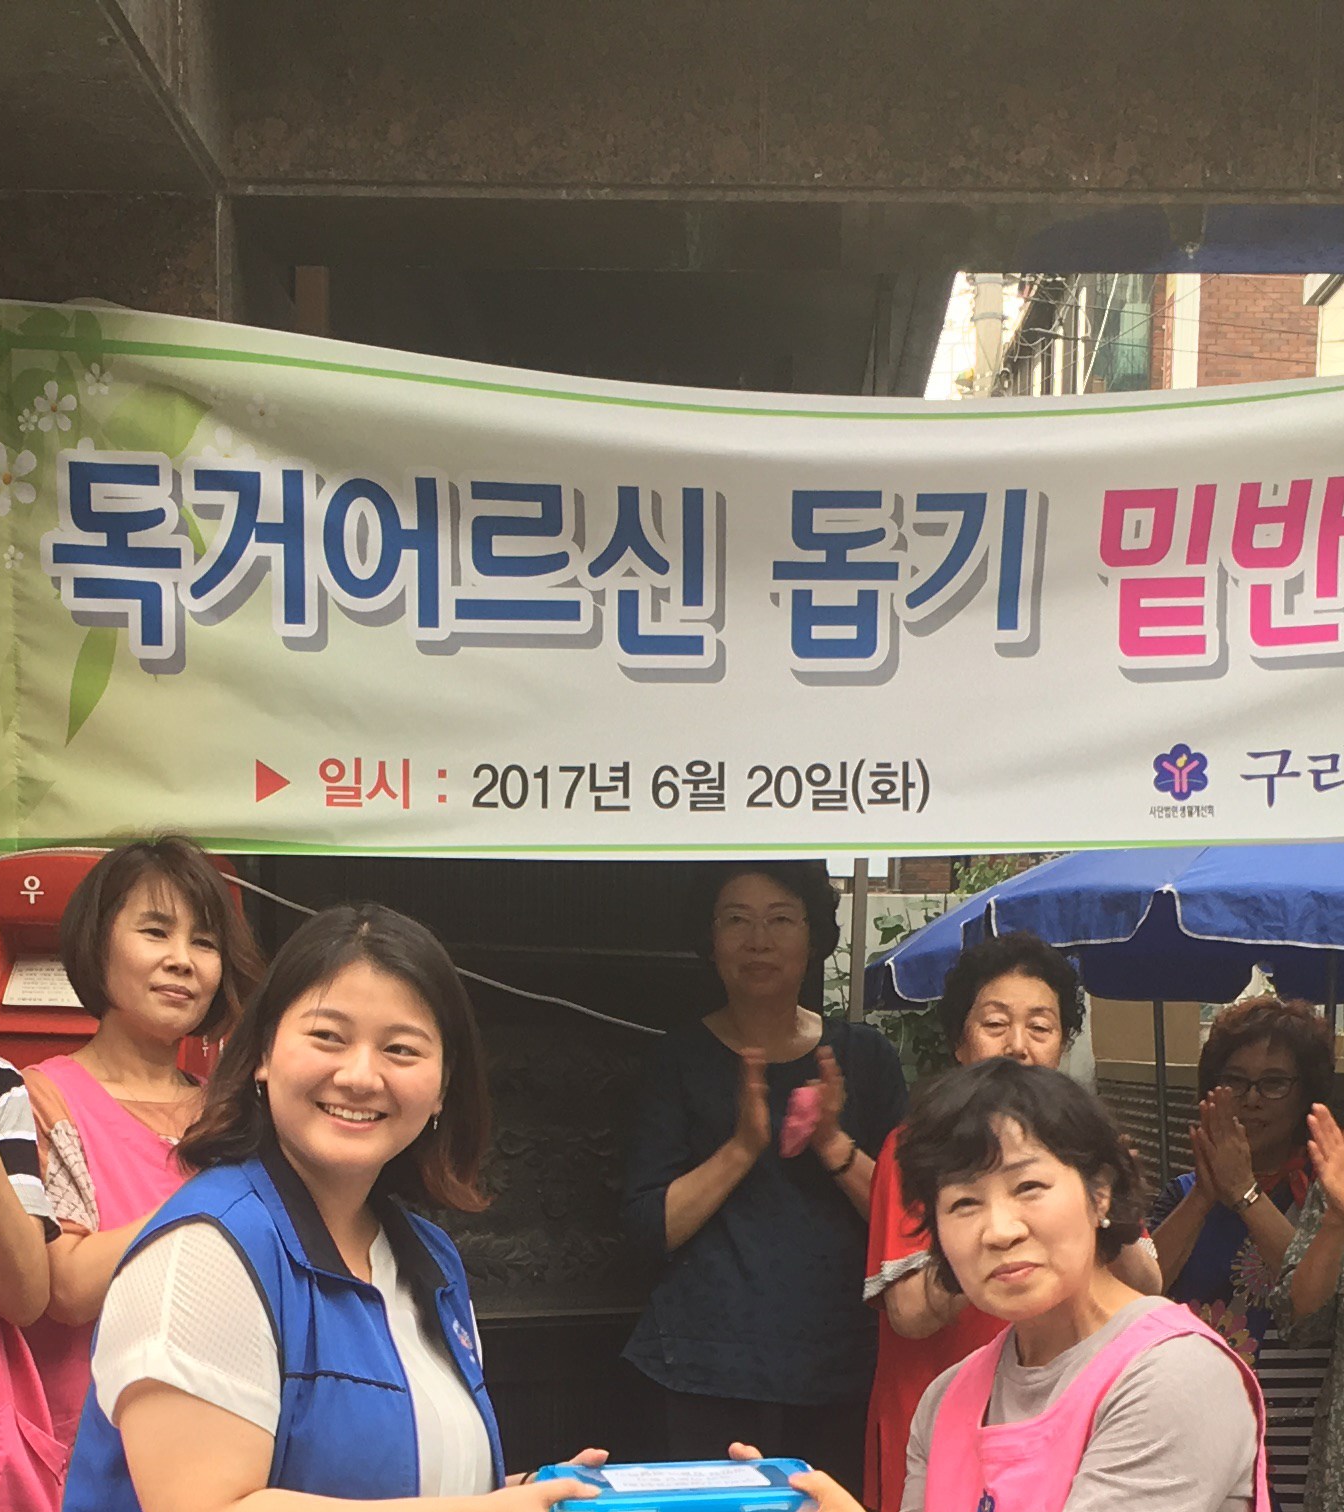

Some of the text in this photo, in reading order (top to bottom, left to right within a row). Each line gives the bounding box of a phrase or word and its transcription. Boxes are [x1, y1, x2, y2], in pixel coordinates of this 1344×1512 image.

[50, 459, 708, 662] 독거어르신
[771, 485, 1030, 664] 돕기
[317, 758, 414, 811] 일시
[471, 761, 633, 813] 2017년
[651, 761, 727, 813] 6월
[745, 760, 931, 815] 20일(화)
[19, 874, 45, 905] 우
